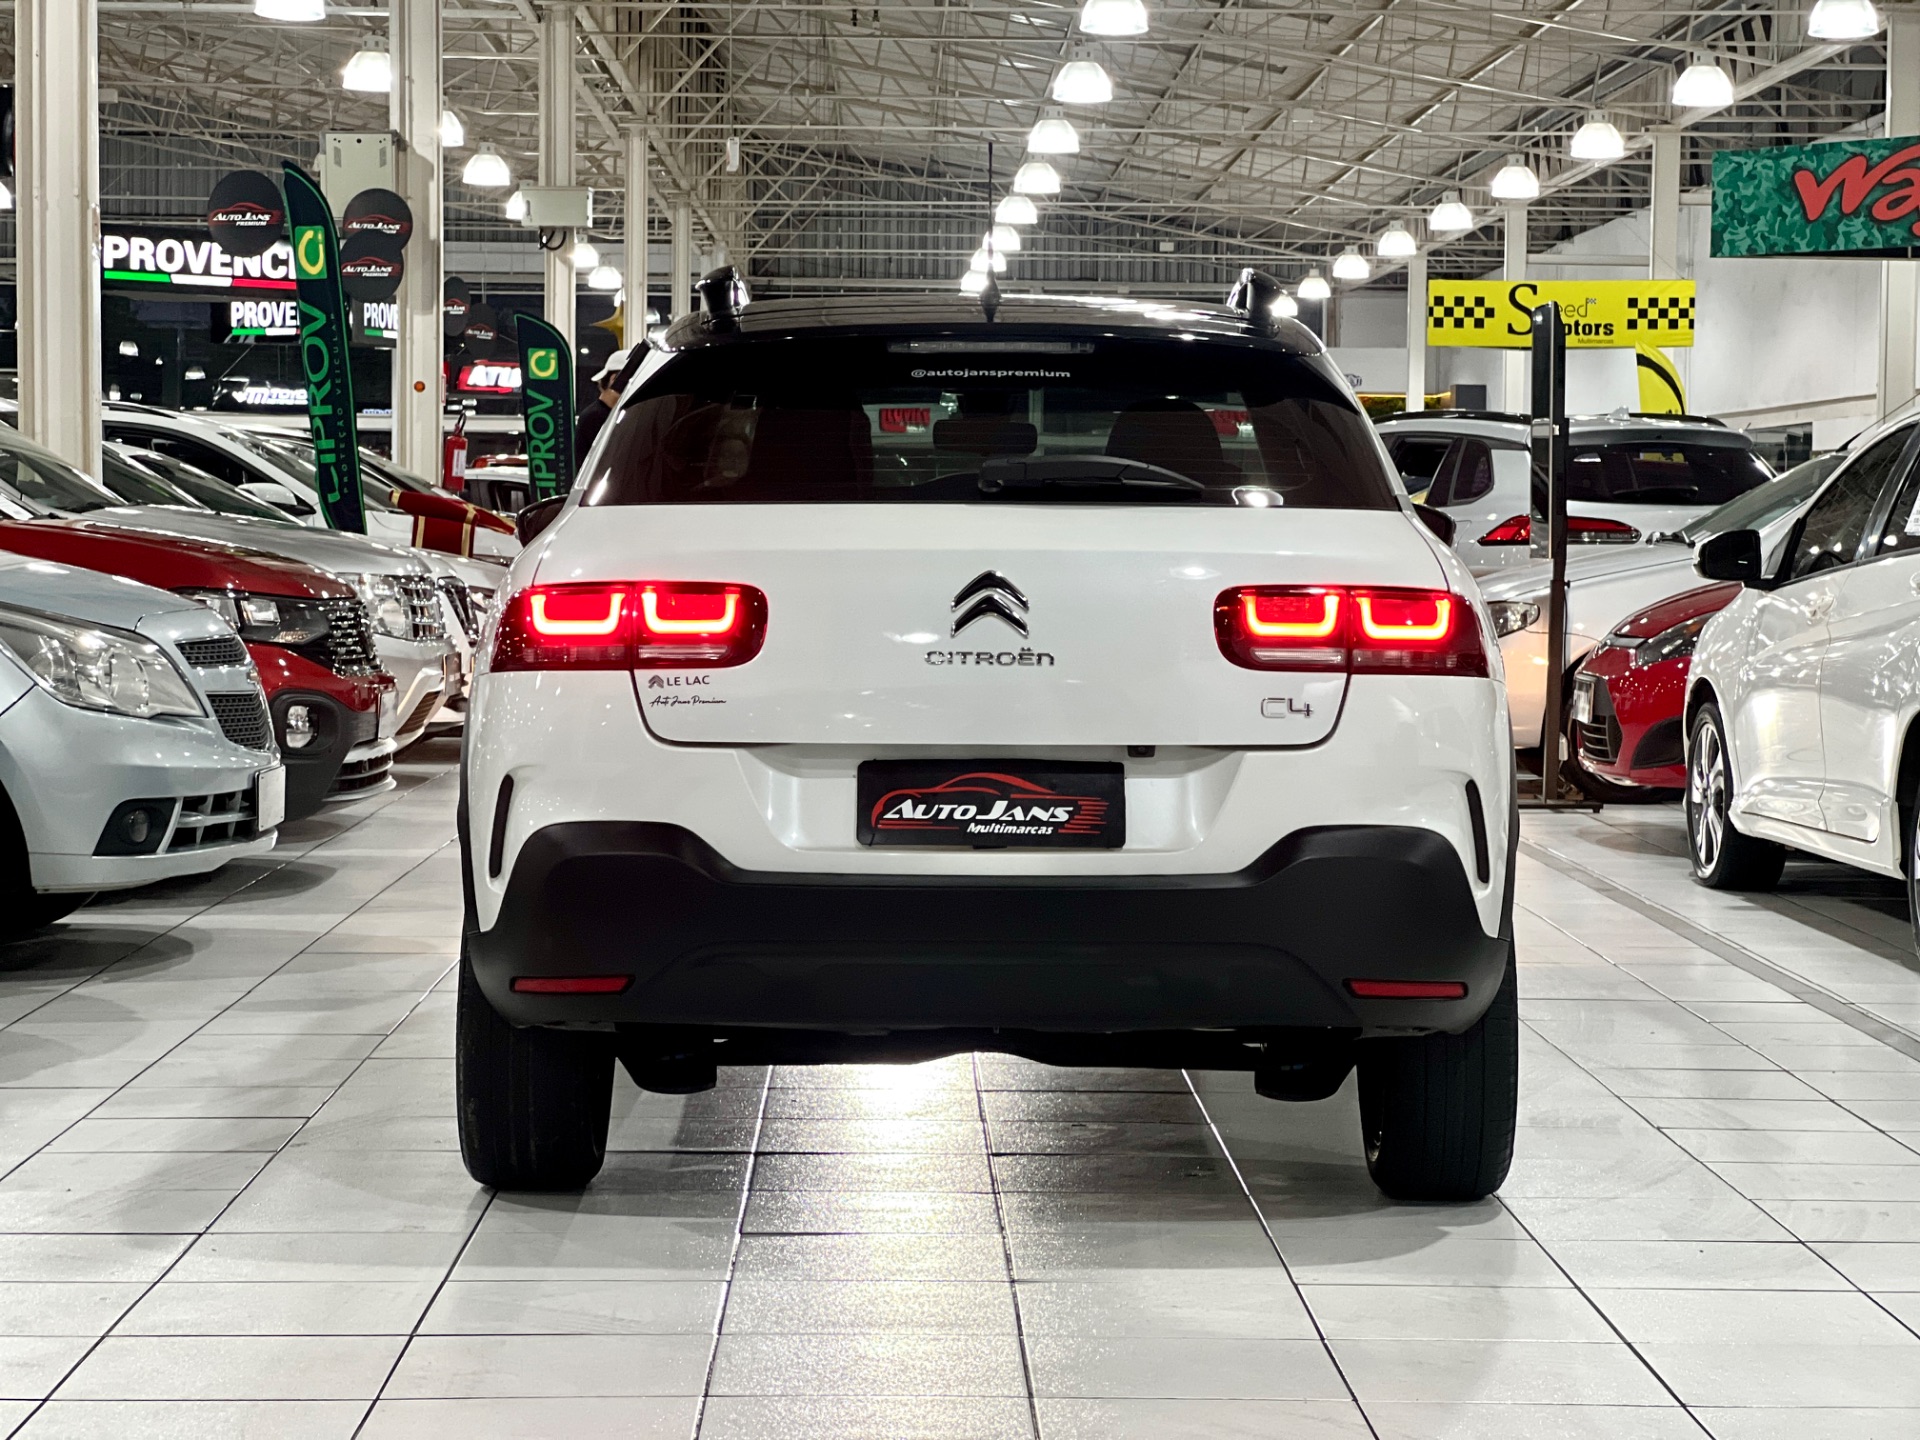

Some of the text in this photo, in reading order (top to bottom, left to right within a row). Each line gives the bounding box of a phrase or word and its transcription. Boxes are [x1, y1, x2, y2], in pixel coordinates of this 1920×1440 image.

[1564, 319, 1614, 336] otors
[911, 368, 1071, 378] @autojanspremium
[666, 674, 710, 686] LE LAC
[1260, 697, 1315, 719] C4
[966, 821, 1054, 836] Multimarcas
